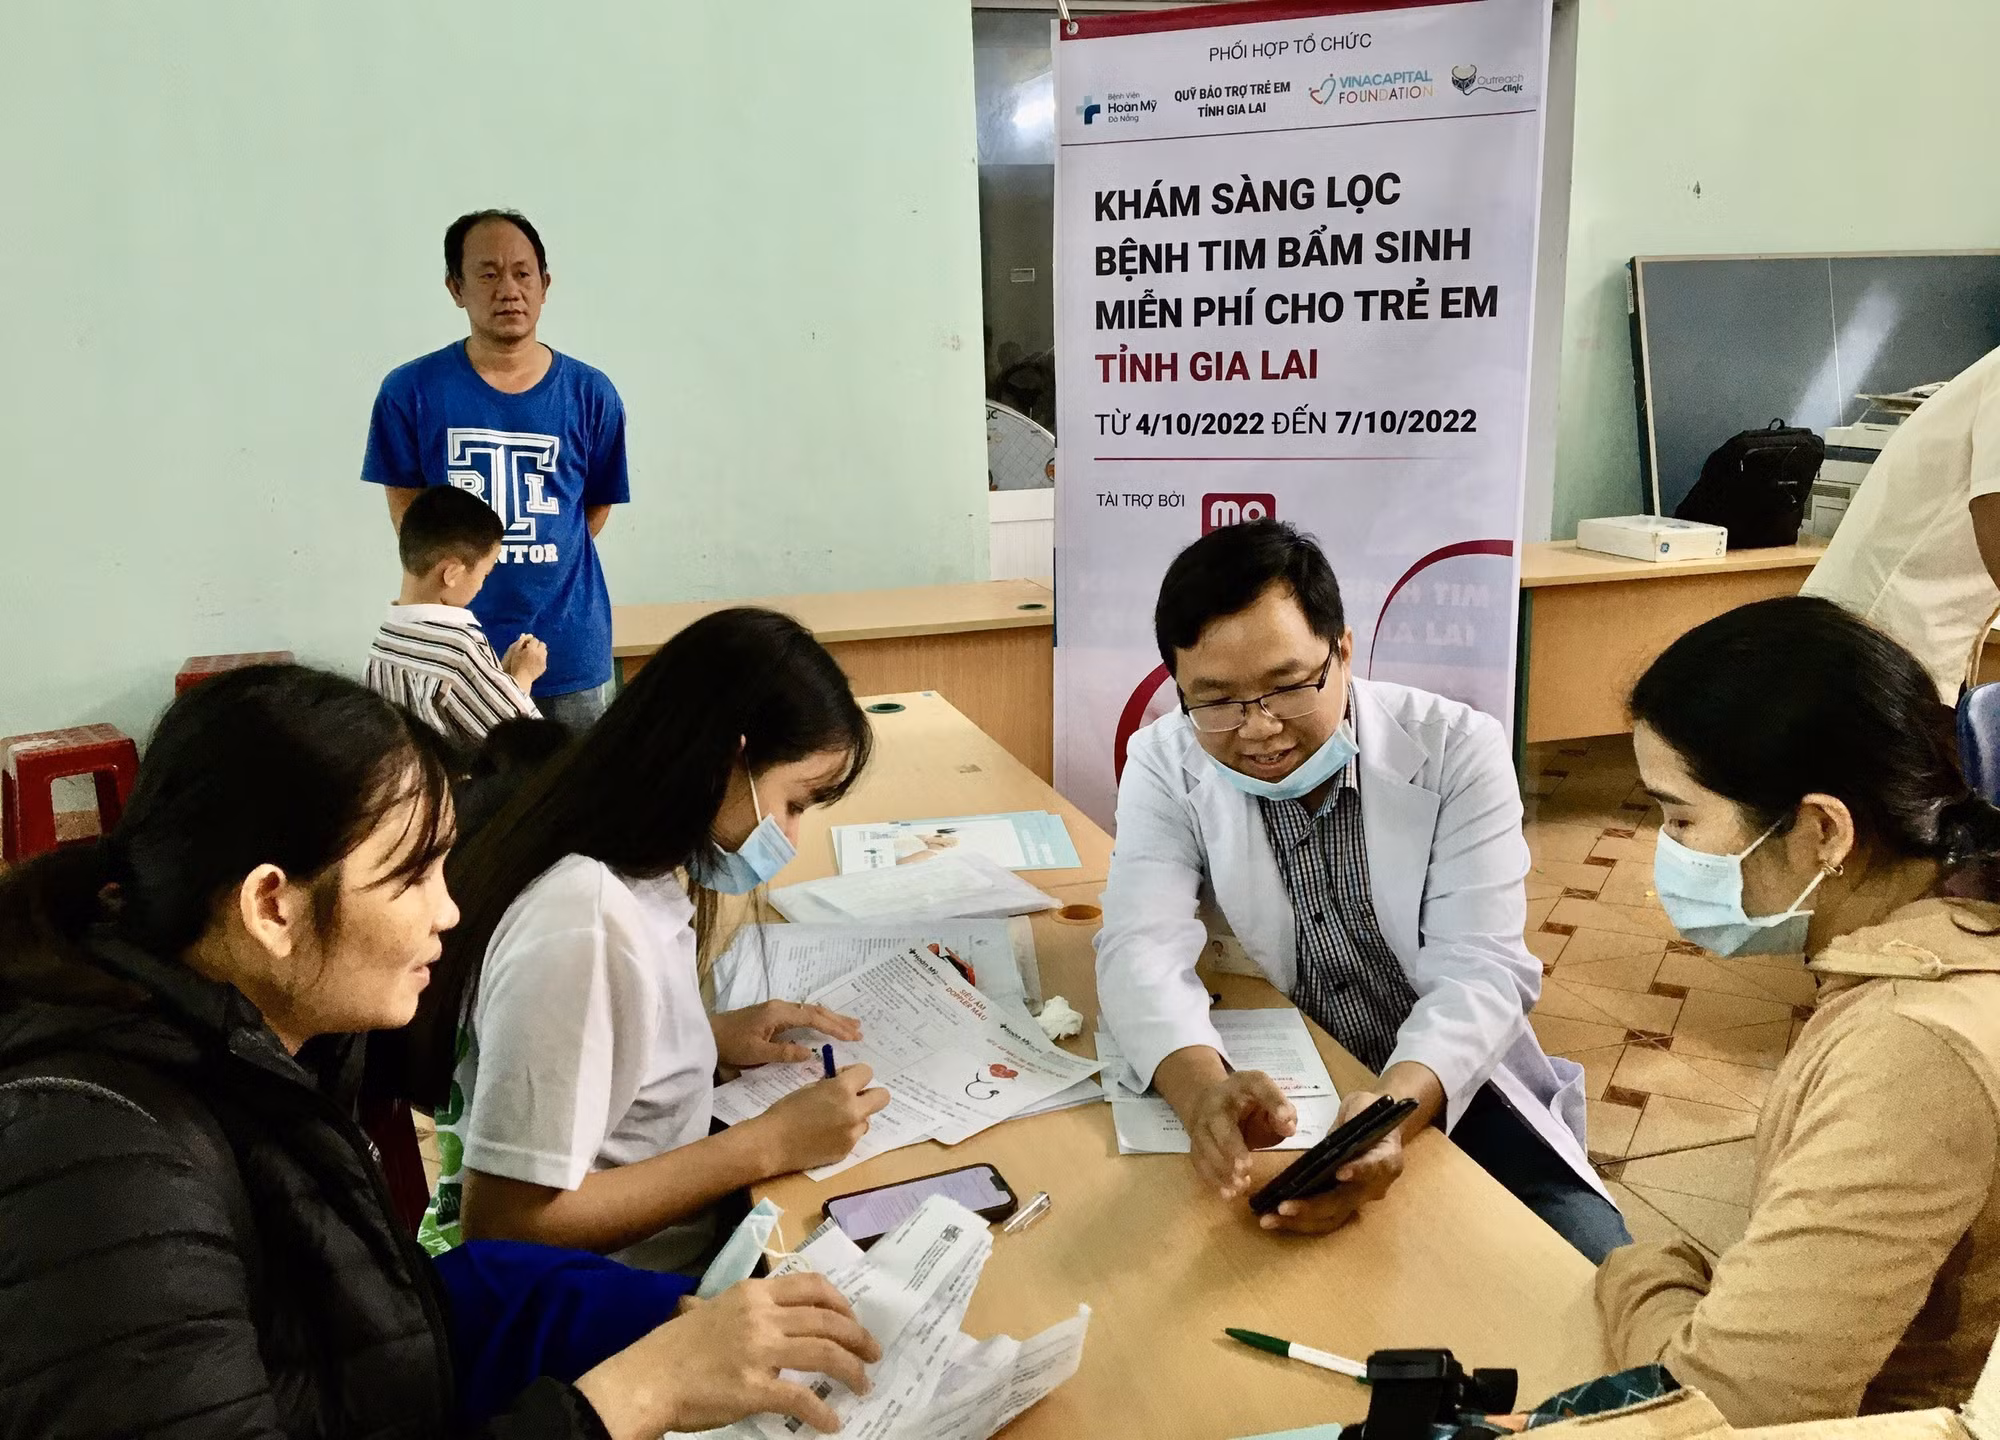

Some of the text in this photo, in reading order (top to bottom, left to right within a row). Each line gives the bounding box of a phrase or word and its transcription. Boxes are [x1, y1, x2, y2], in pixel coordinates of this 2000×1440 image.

[1209, 31, 1372, 62] PHỐI HỢP TỔ CHỨC
[1339, 70, 1433, 88] VINACAPITAL
[1477, 74, 1524, 86] Outreach
[1502, 84, 1523, 93] Clinic
[1174, 79, 1291, 102] QUỸ BẢO TRỢ TRẺ EM
[1339, 85, 1434, 104] FOUNDATION
[1108, 100, 1157, 113] Hoàn Mỹ
[1198, 102, 1266, 117] TỈNH GIA LAI
[1095, 172, 1401, 221] KHÁM SÀNG LỌC
[1095, 224, 1471, 282] BỆNH TIM BẨM SINH
[1095, 277, 1498, 330] MIỄN PHÍ CHO TRẺ EM
[1095, 344, 1318, 383] TỈNH GIA LAI
[1095, 404, 1477, 437] TỪ 4/10/2022 ĐẾN 7/10/2022
[524, 473, 560, 515] L
[1096, 491, 1185, 510] TÀI TRỢ BỞI
[495, 543, 559, 564] NTOR
